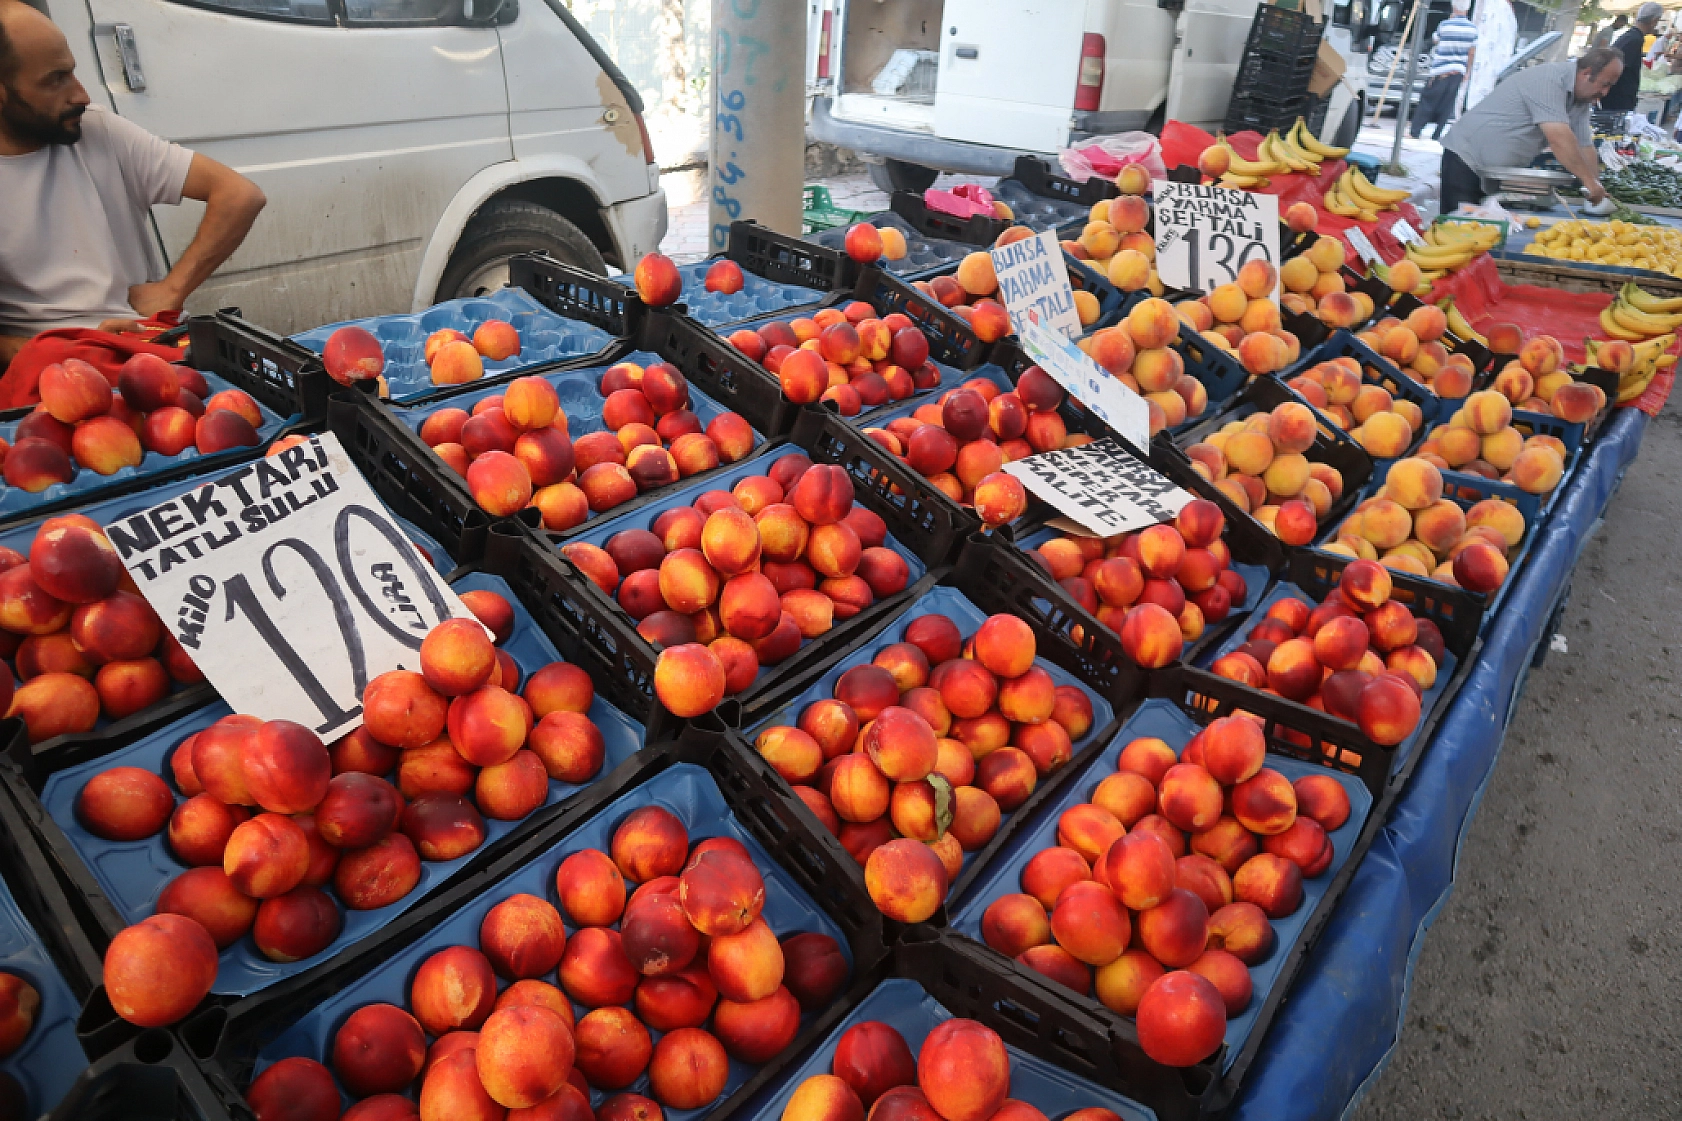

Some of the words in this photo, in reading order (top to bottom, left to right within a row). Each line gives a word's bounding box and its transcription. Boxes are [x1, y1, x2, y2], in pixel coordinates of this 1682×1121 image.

[1170, 197, 1247, 221] YARMA
[1177, 184, 1259, 209] BURSA
[991, 236, 1047, 273] BURSA
[1000, 261, 1056, 305] YARMA
[240, 473, 340, 534] SULU
[223, 504, 454, 734] 120
